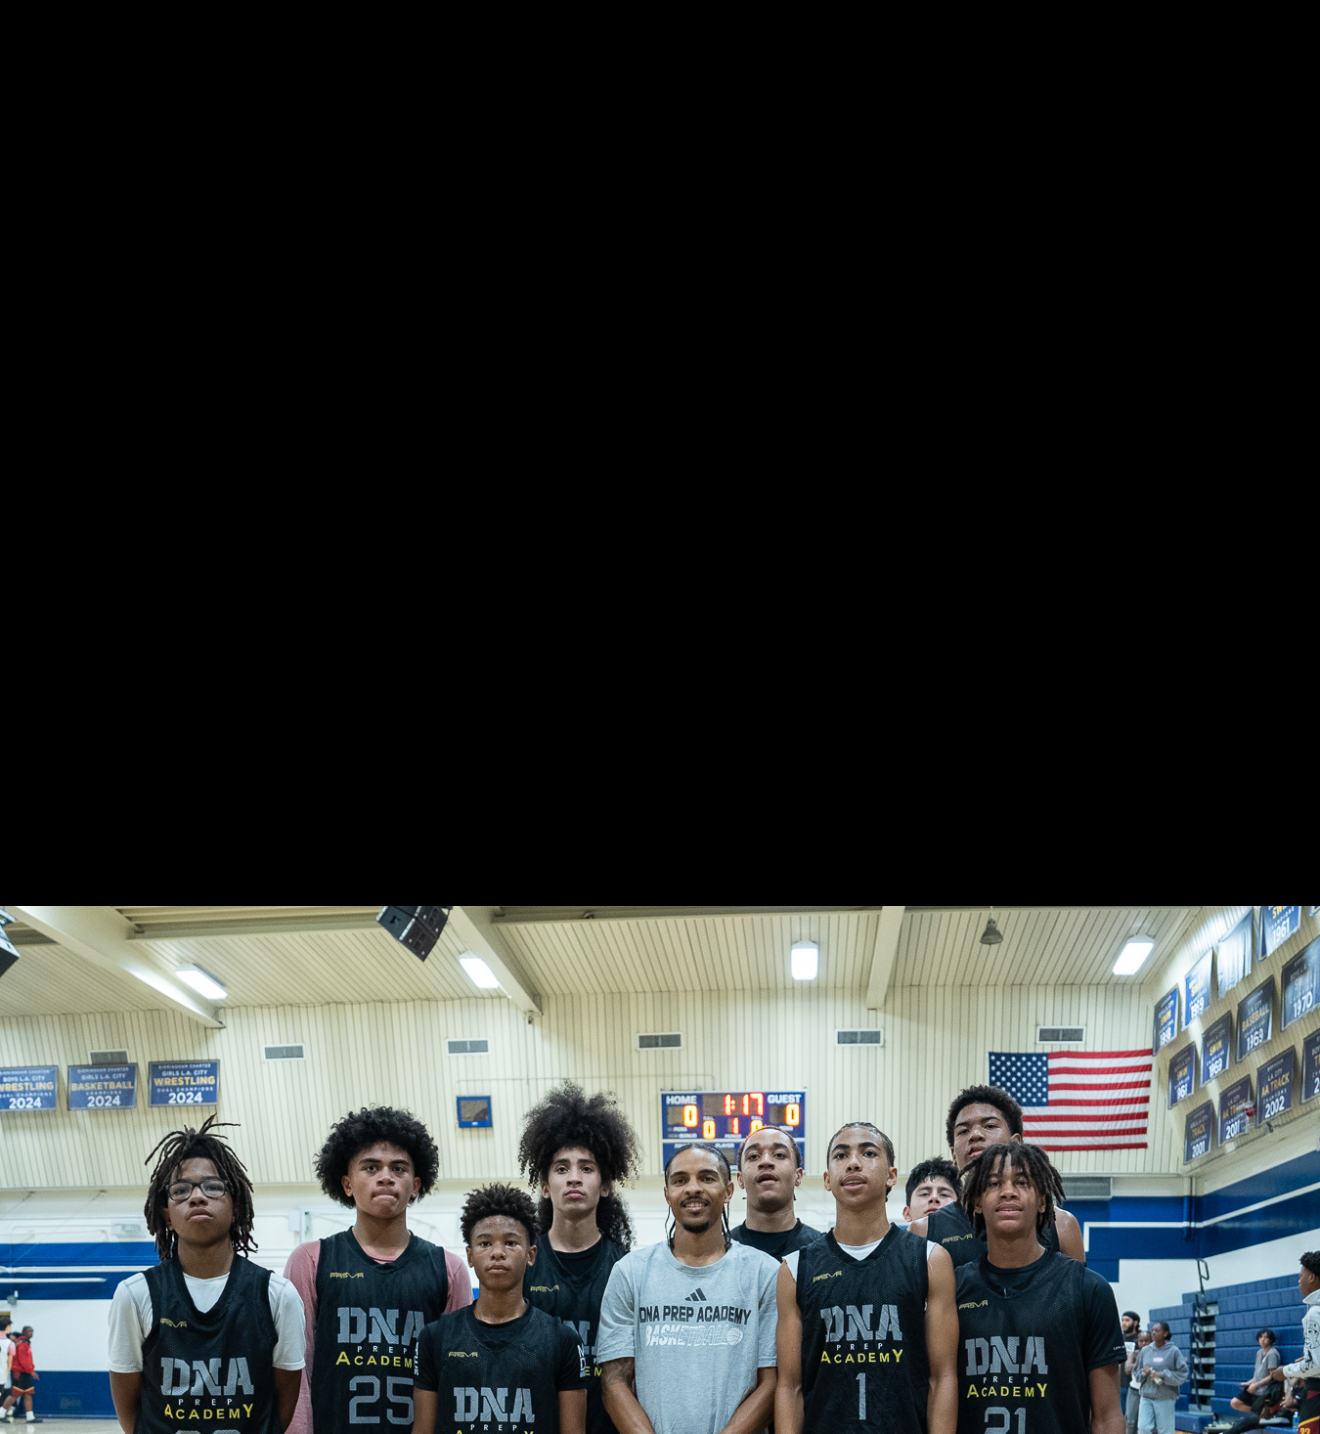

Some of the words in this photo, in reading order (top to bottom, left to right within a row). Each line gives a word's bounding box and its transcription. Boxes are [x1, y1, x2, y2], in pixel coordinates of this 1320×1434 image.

[1242, 1003, 1270, 1032] BASEBALL
[72, 1081, 134, 1091] BASKETBALL
[154, 1076, 216, 1086] WRESTLING
[1270, 1072, 1290, 1092] TRACK
[9, 1096, 42, 1109] 2024
[87, 1095, 120, 1108] 2024
[168, 1092, 203, 1104] 2024
[666, 1096, 697, 1105] HOME
[724, 1092, 764, 1116] 1:17
[767, 1094, 802, 1104] GUEST
[1265, 1096, 1285, 1118] 2002
[683, 1104, 698, 1128] 0
[785, 1103, 800, 1126] 0
[702, 1120, 716, 1140] 0
[639, 1306, 660, 1323] DNA
[663, 1306, 694, 1322] PREP
[697, 1306, 752, 1325] ACADEMY
[820, 1304, 902, 1342] DNA
[337, 1307, 426, 1346] DNA
[357, 1346, 408, 1354] PREP
[836, 1342, 883, 1351] PREP
[336, 1351, 412, 1368] ACADEM
[820, 1349, 903, 1364] ACADEMY
[965, 1336, 1048, 1376] DNA
[160, 1357, 254, 1396] DNA
[983, 1376, 1029, 1384] PREP
[856, 1372, 866, 1420] 1
[966, 1383, 1047, 1398] ACADEMY
[178, 1398, 233, 1406] PREP
[349, 1375, 414, 1425] 25
[454, 1387, 535, 1423] DNA
[164, 1403, 253, 1420] ACADEMY
